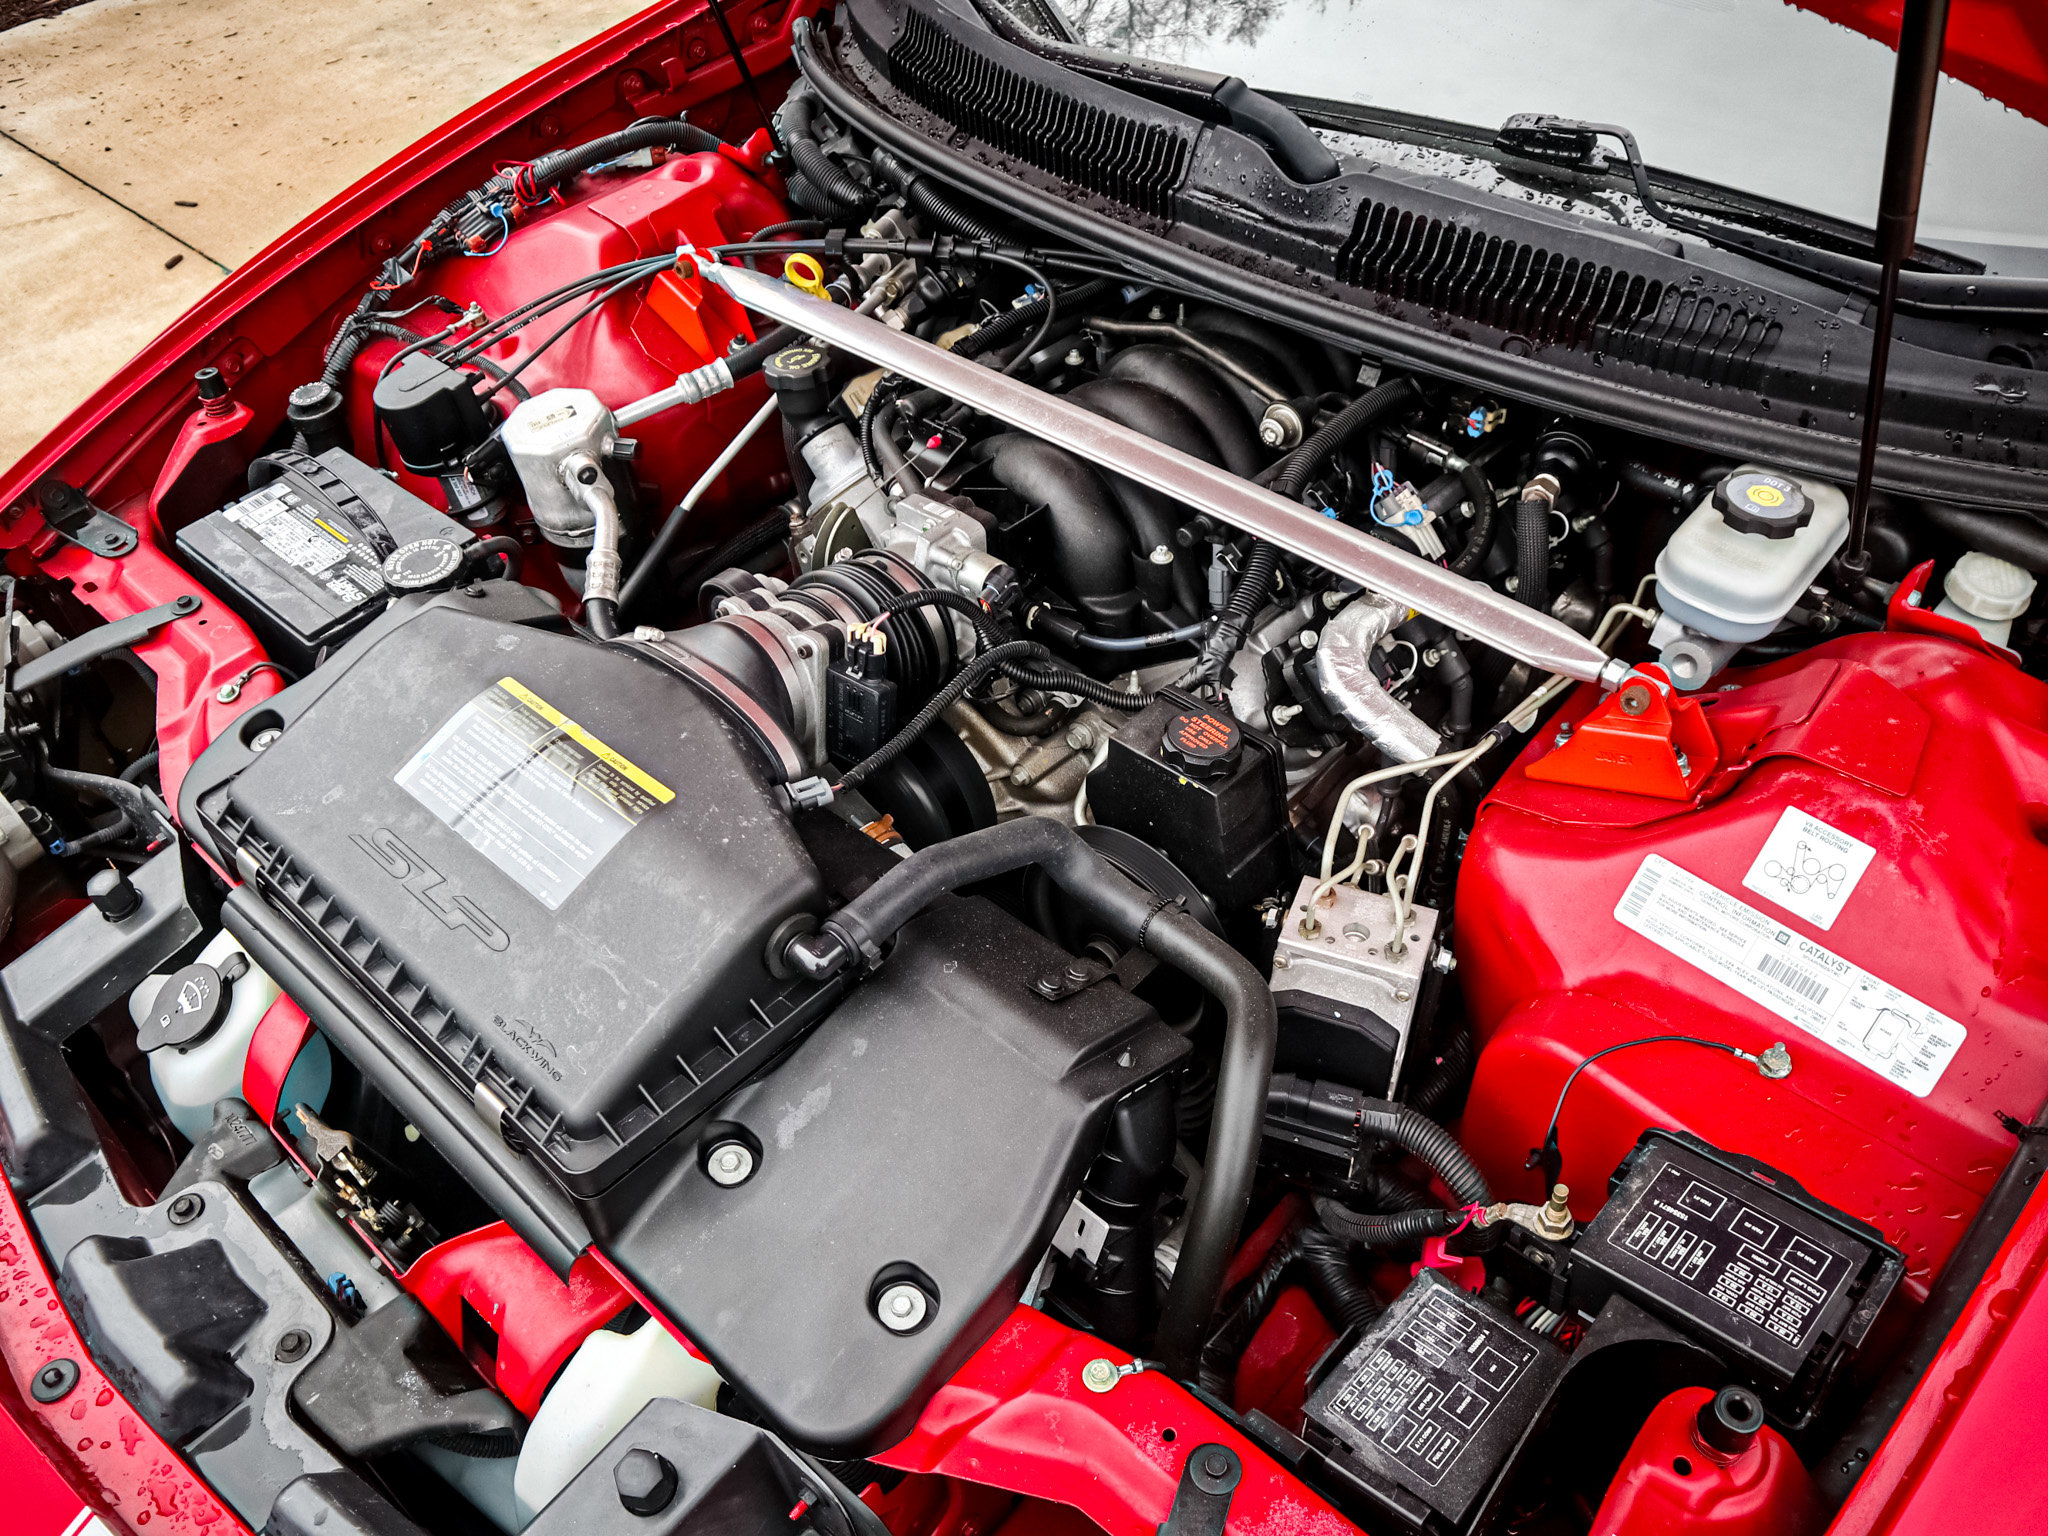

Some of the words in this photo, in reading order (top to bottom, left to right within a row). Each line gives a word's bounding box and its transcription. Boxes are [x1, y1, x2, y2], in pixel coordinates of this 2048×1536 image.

[1762, 476, 1783, 490] DOT
[1782, 483, 1792, 492] 3
[525, 696, 544, 711] CAUTION
[1178, 715, 1189, 723] DO
[1188, 722, 1202, 731] NOT
[1201, 730, 1229, 748] OVERFILL
[1190, 715, 1229, 741] STEERING
[1201, 713, 1231, 733] POWER
[1178, 729, 1208, 749] APPROVED
[1184, 725, 1198, 736] USE
[1197, 734, 1214, 745] ONLY
[608, 755, 628, 771] CAUTION
[1801, 825, 1820, 839] BELT
[1818, 834, 1850, 854] ROUTING
[1803, 819, 1814, 828] V8
[1812, 824, 1854, 849] ACCESSORY
[350, 830, 513, 956] SLP
[1697, 889, 1730, 911] CONTROL
[1730, 907, 1777, 937] INFORMATION
[1710, 888, 1739, 908] VEHICLE
[1738, 904, 1771, 926] EMISSION
[1699, 897, 1721, 912] GENERAL
[1738, 919, 1771, 940] CORPORATION
[1796, 939, 1852, 976] CATALYST
[486, 1013, 568, 1083] BLACKWING
[1699, 1197, 1712, 1207] FAN
[1750, 1224, 1764, 1235] FAN
[1749, 1252, 1769, 1267] HORN
[1803, 1254, 1817, 1265] FAN
[1749, 1285, 1765, 1296] PUMP
[1787, 1274, 1808, 1289] LAMP
[1805, 1284, 1821, 1296] FOG
[1762, 1292, 1777, 1303] FUEL
[1416, 1401, 1427, 1412] AIR
[1422, 1391, 1435, 1404] PUMP
[1455, 1394, 1473, 1414] STARTER
[1412, 1435, 1425, 1449] A/C
[1431, 1448, 1444, 1462] FUEL
[1439, 1437, 1453, 1452] PUMP
